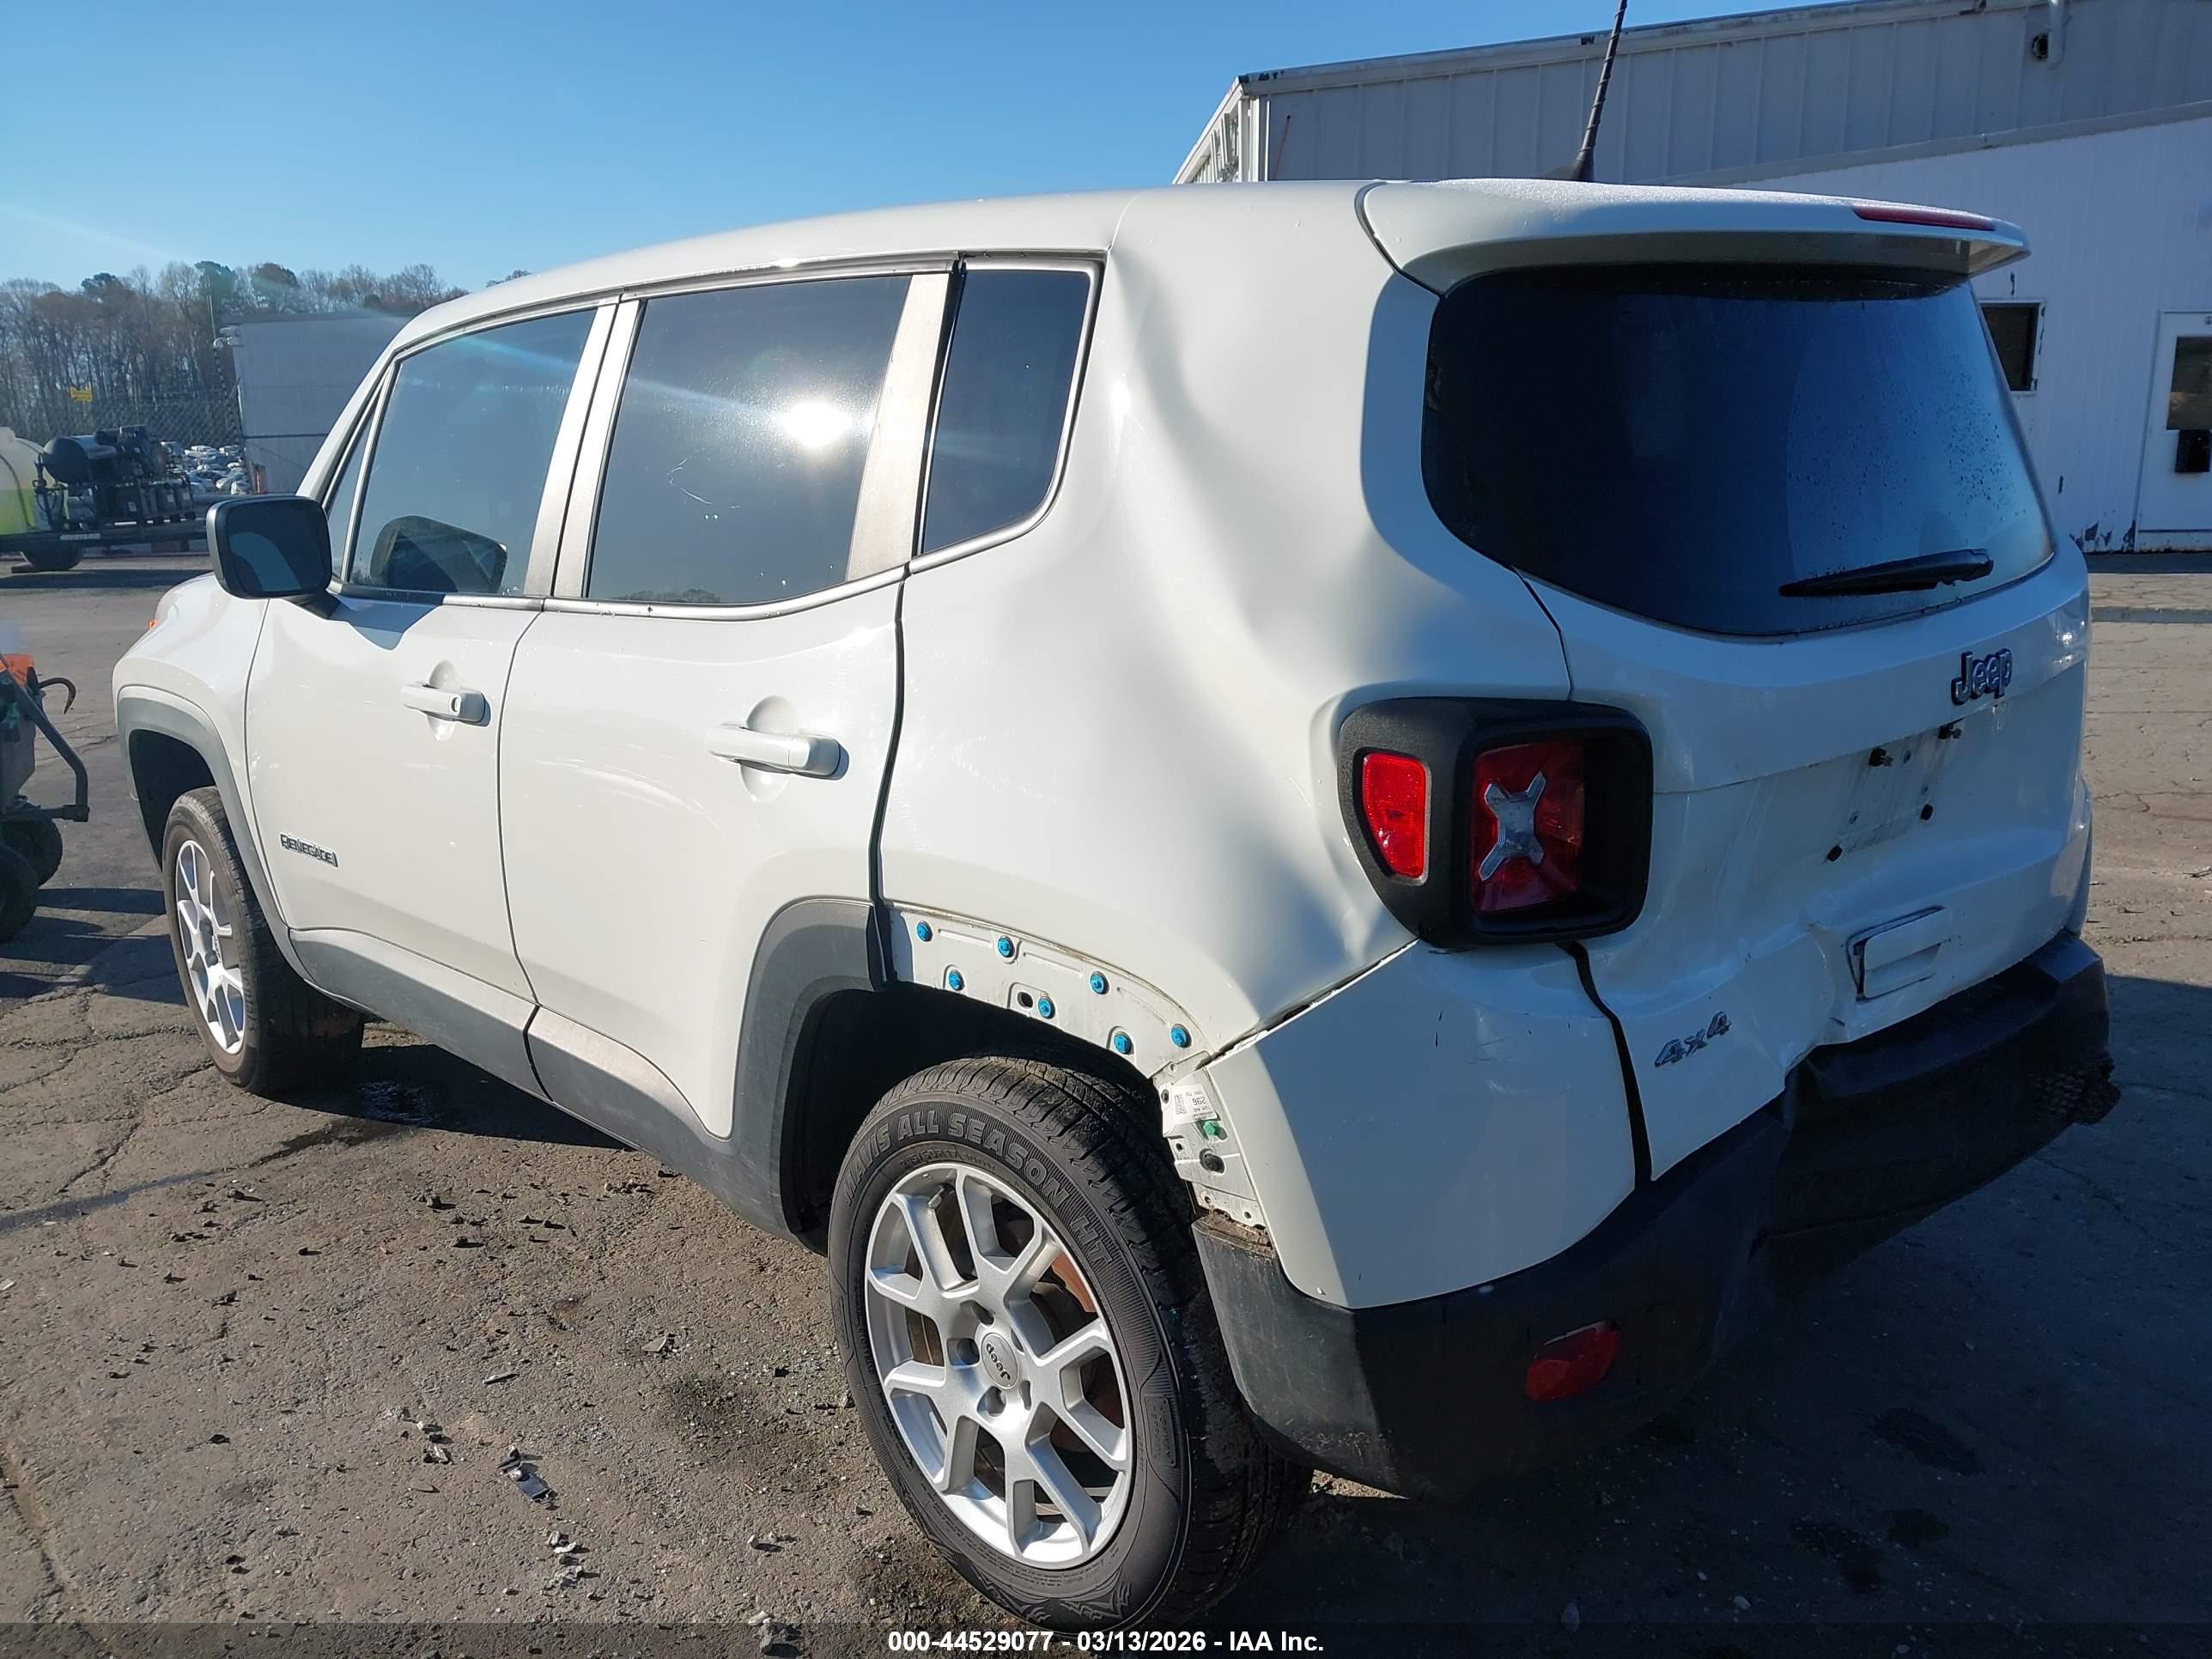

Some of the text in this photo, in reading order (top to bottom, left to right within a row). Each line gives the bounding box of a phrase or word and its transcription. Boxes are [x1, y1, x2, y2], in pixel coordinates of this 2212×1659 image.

[1951, 647, 2013, 706] Jeep
[279, 832, 339, 868] RENEGADE
[843, 1109, 1115, 1265] MAVIS ALL SEASON HT
[986, 1342, 1012, 1381] Jeep
